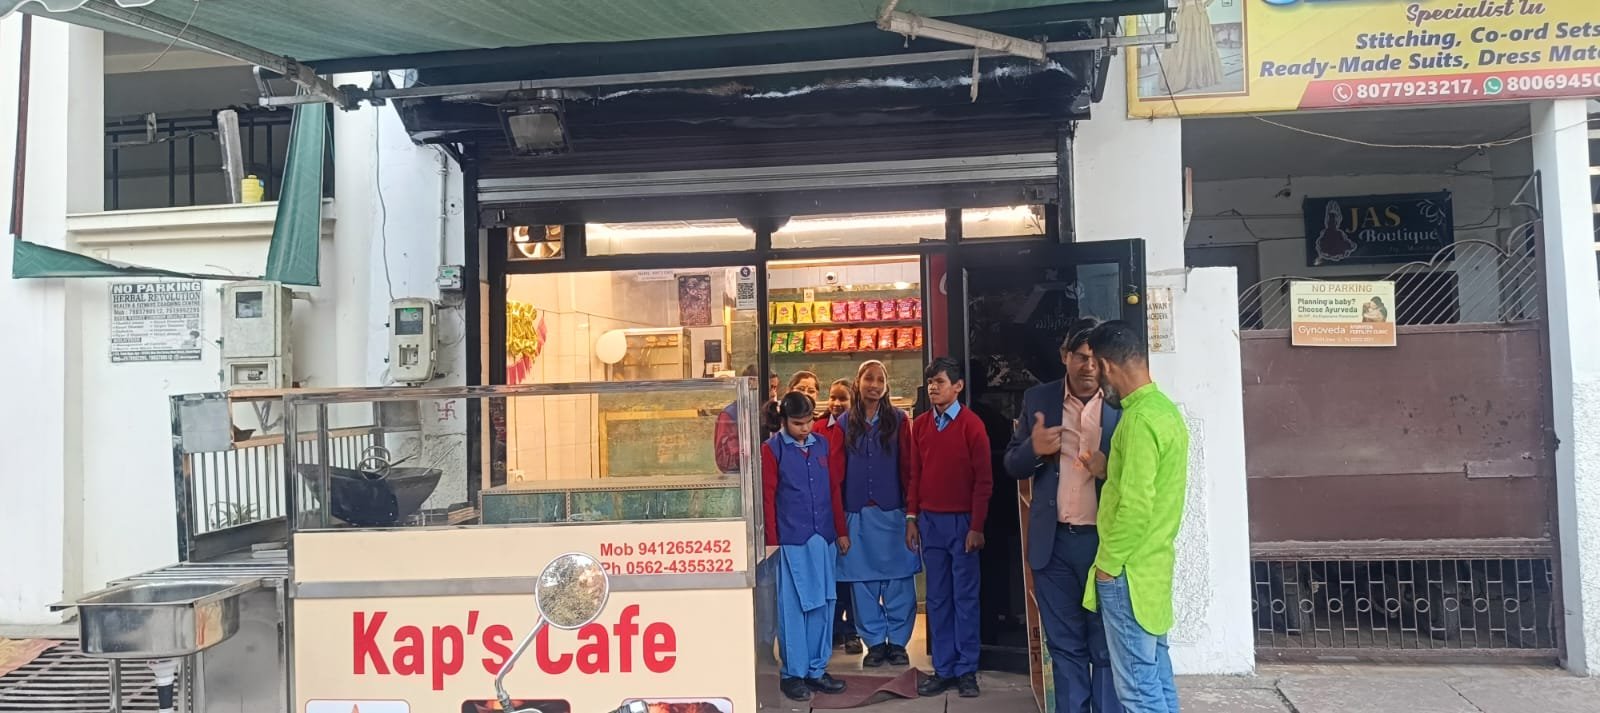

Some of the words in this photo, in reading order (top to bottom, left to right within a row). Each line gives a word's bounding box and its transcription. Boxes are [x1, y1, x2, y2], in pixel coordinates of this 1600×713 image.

[1406, 0, 1513, 27] Specialist
[1356, 30, 1462, 50] Stitching,
[1470, 22, 1549, 43] Co-ord
[1555, 21, 1600, 39] Sets
[1260, 53, 1401, 79] Ready-Made
[1408, 51, 1470, 70] Suits,
[1478, 49, 1541, 66] Dress
[1357, 79, 1478, 98] 8077923217,
[1345, 206, 1401, 233] JAS
[1359, 228, 1439, 244] Boutique
[113, 284, 133, 294] NO
[137, 282, 201, 293] PARKING
[1312, 284, 1326, 293] NO
[1329, 283, 1373, 293] PARKING
[113, 294, 146, 303] HERBAL
[148, 292, 200, 302] REVOLUTION
[1297, 298, 1327, 306] Planning
[1334, 298, 1356, 306] baby?
[1325, 306, 1358, 314] Ayurveda
[1299, 325, 1346, 336] Gynoveda
[600, 543, 634, 556] Mob
[638, 540, 732, 555] 9412652452
[601, 562, 621, 575] Ph
[626, 559, 734, 574] 0562-4355322
[352, 611, 514, 691] Kap's
[535, 604, 677, 675] Cafe
